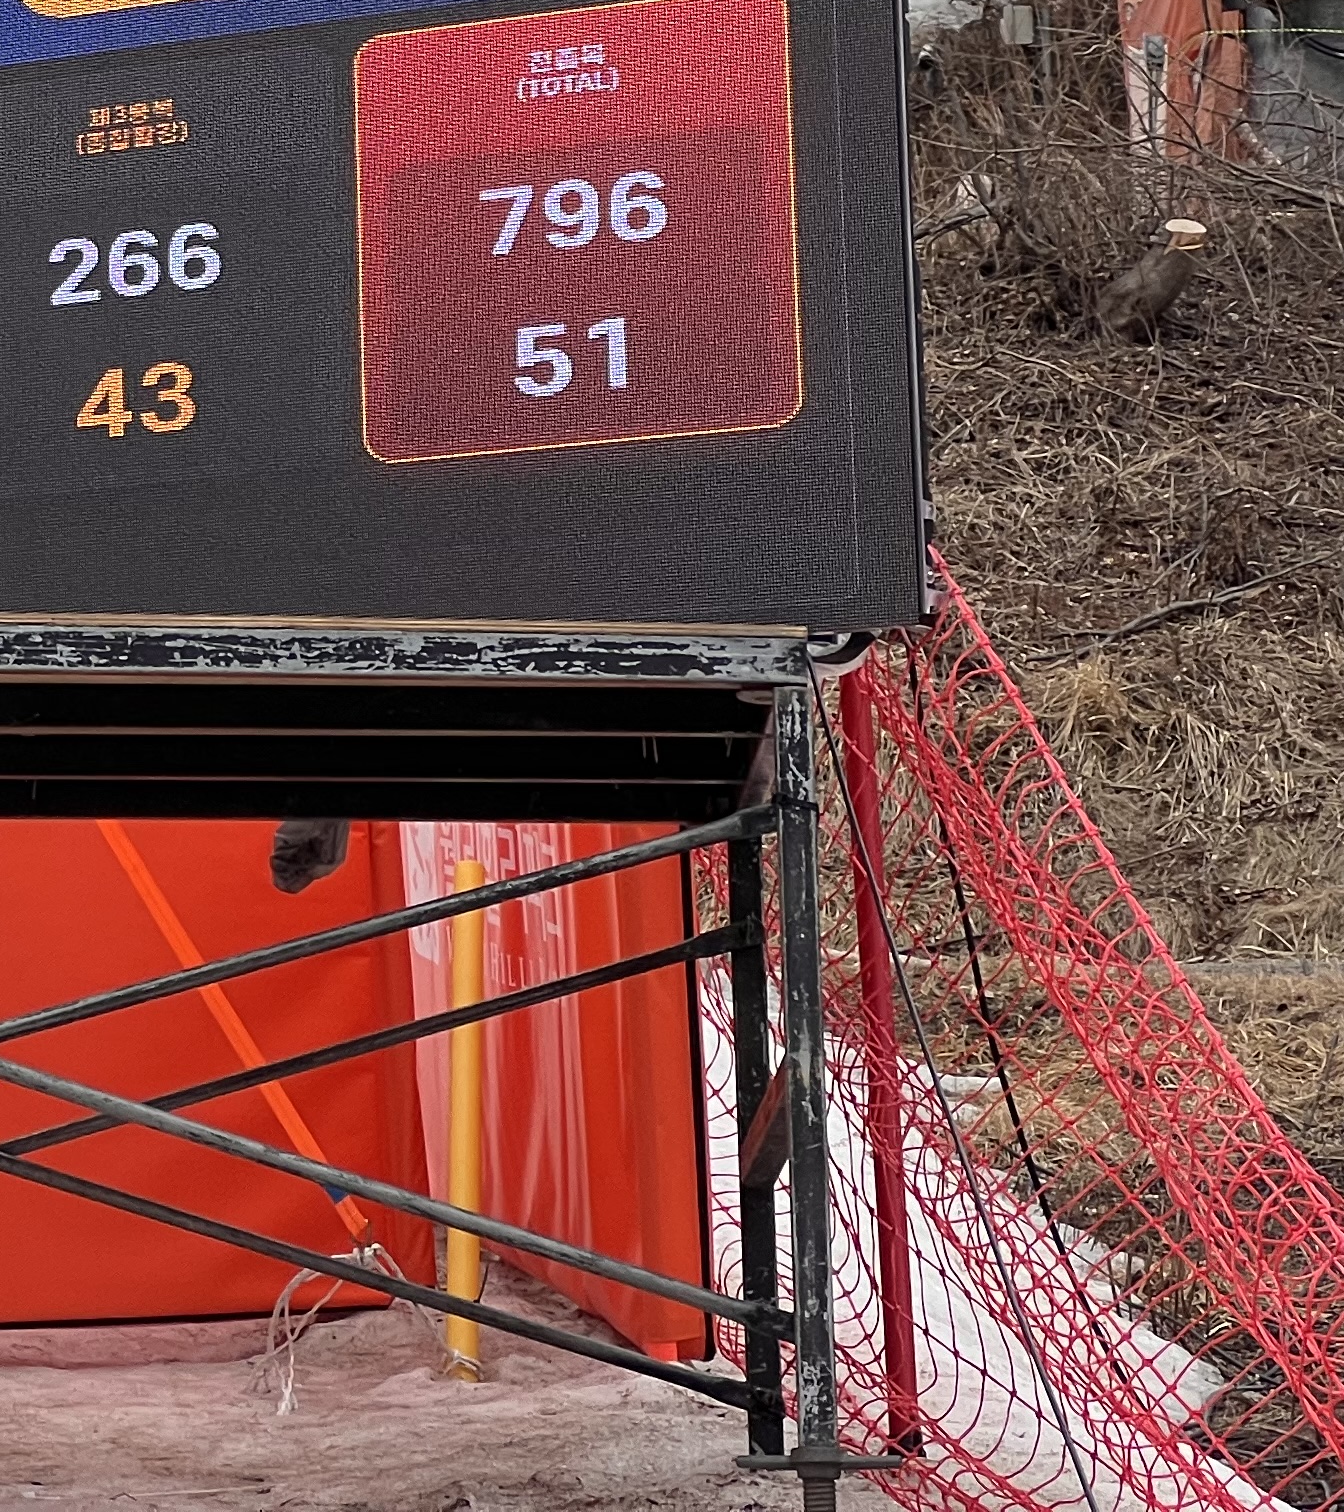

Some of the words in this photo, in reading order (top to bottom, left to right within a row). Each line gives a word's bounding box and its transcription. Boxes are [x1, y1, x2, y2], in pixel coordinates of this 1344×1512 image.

[479, 170, 671, 257] 796
[49, 221, 223, 306] 266
[513, 316, 629, 398] 51
[75, 361, 196, 437] 43
